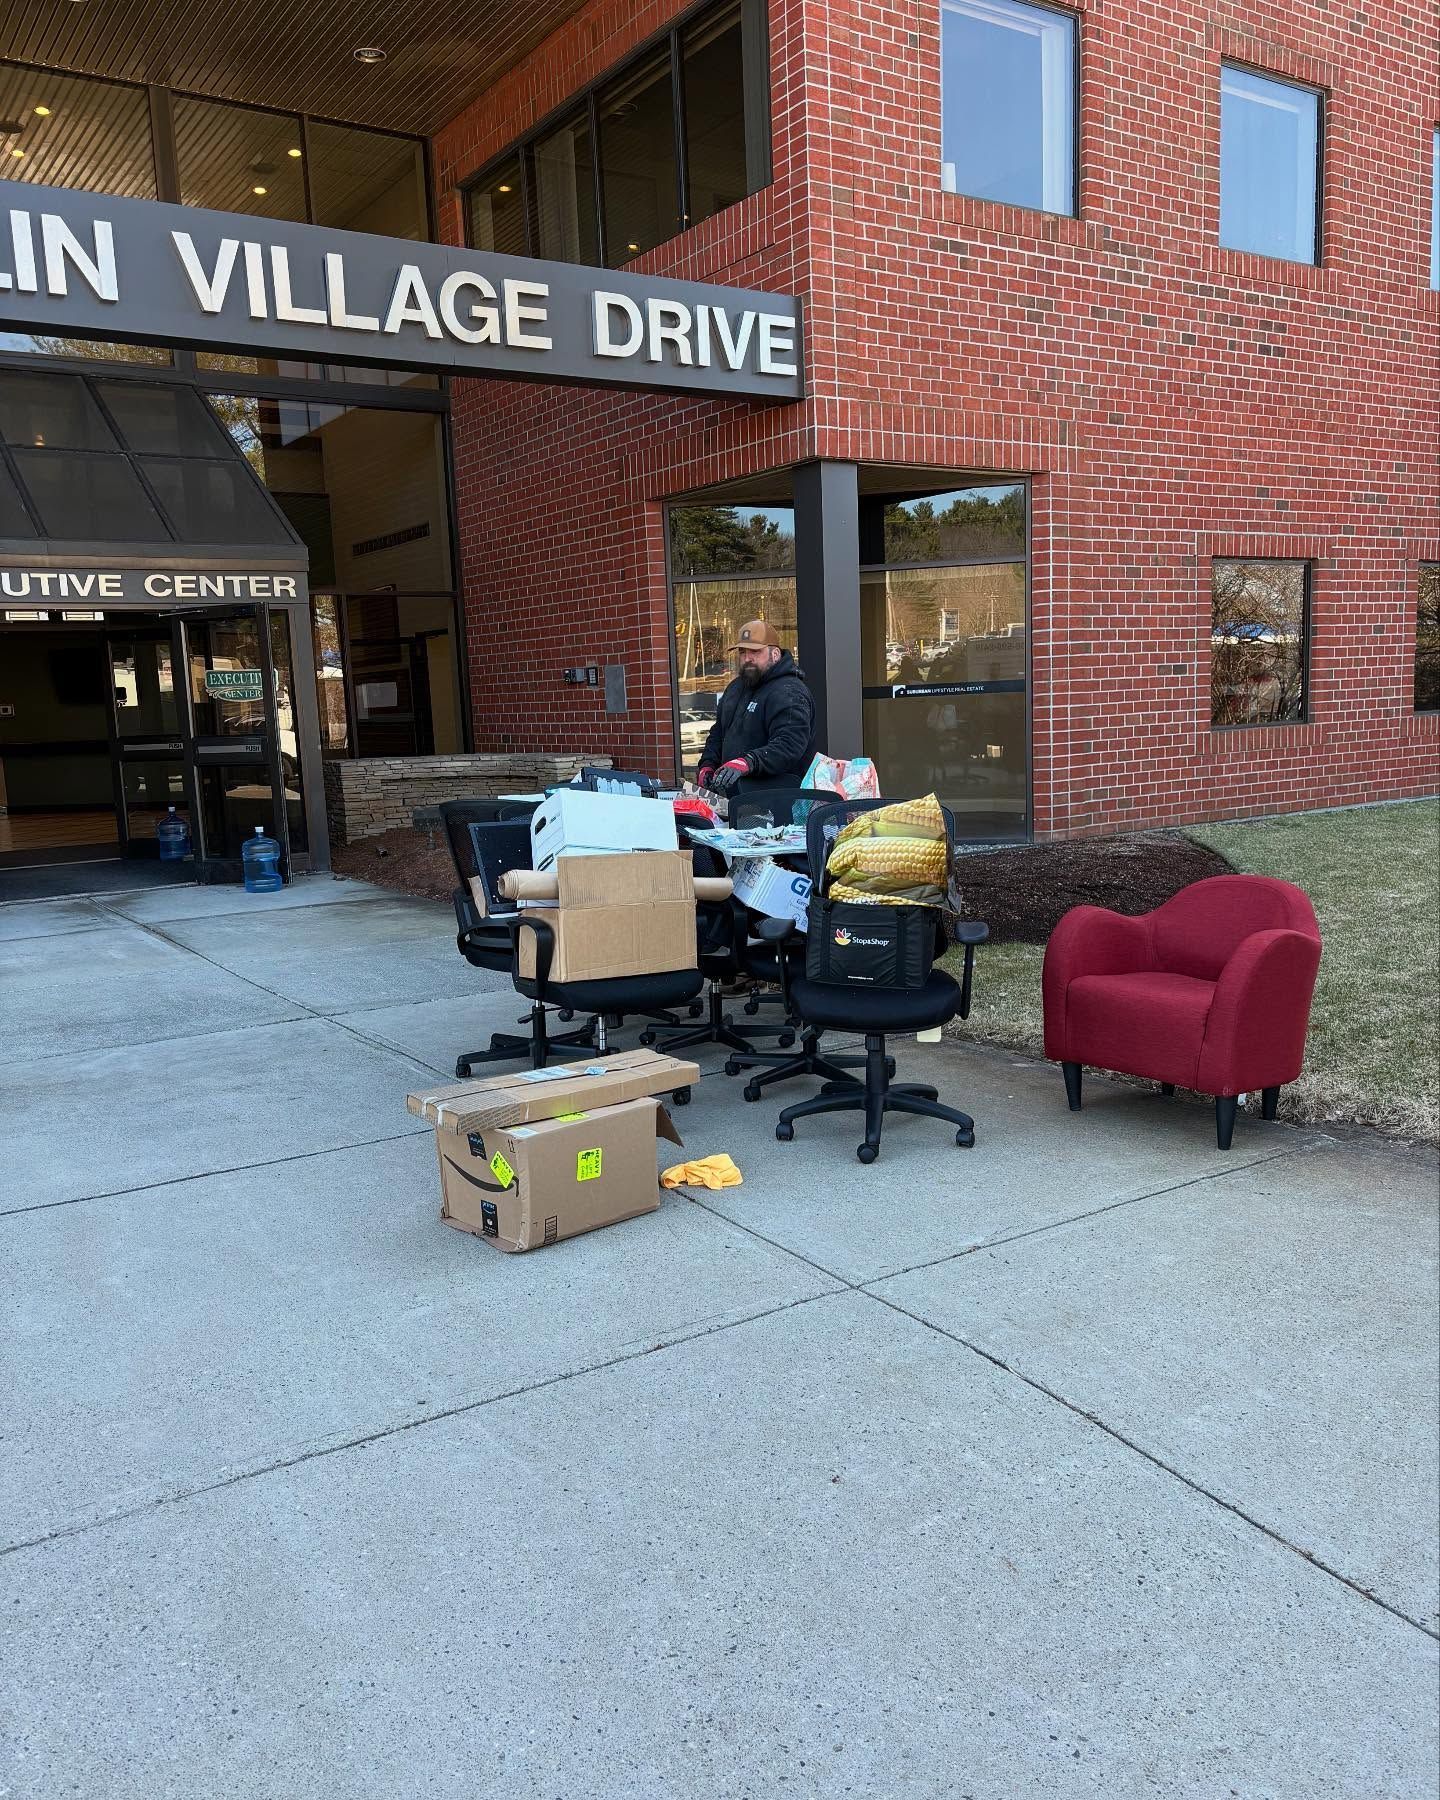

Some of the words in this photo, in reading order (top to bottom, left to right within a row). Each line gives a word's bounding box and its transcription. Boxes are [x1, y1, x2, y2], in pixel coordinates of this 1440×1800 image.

[0, 209, 119, 302] IN
[170, 230, 553, 351] VILLAGE
[591, 289, 798, 376] DRIVE
[1, 572, 124, 598] UTIVE
[144, 573, 297, 598] CENTER
[209, 672, 262, 685] EXECUTI
[225, 689, 262, 698] CENTER
[852, 936, 889, 947] Stop&Shop
